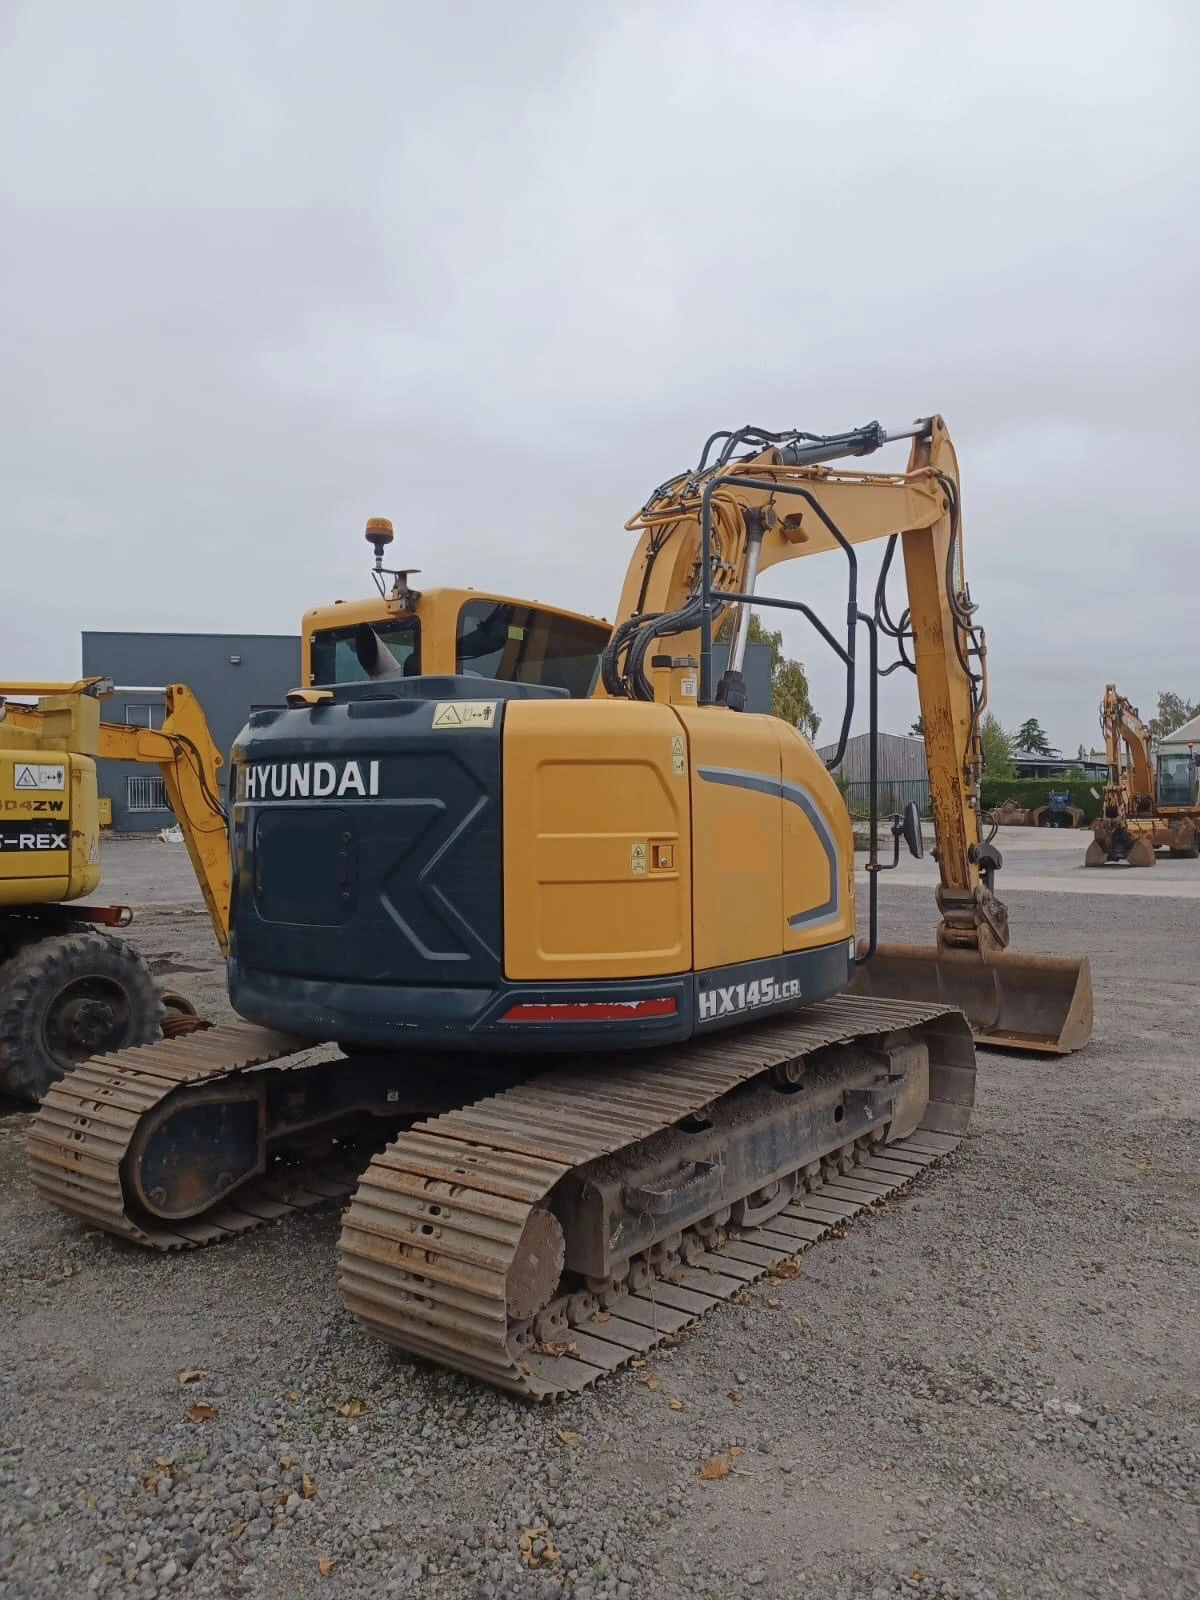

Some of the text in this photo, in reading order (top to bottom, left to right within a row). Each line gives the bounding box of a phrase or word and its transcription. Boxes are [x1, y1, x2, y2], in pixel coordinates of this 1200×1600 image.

[245, 761, 379, 798] HYUNDAI
[0, 800, 63, 811] 04ZW
[0, 833, 67, 849] -REX
